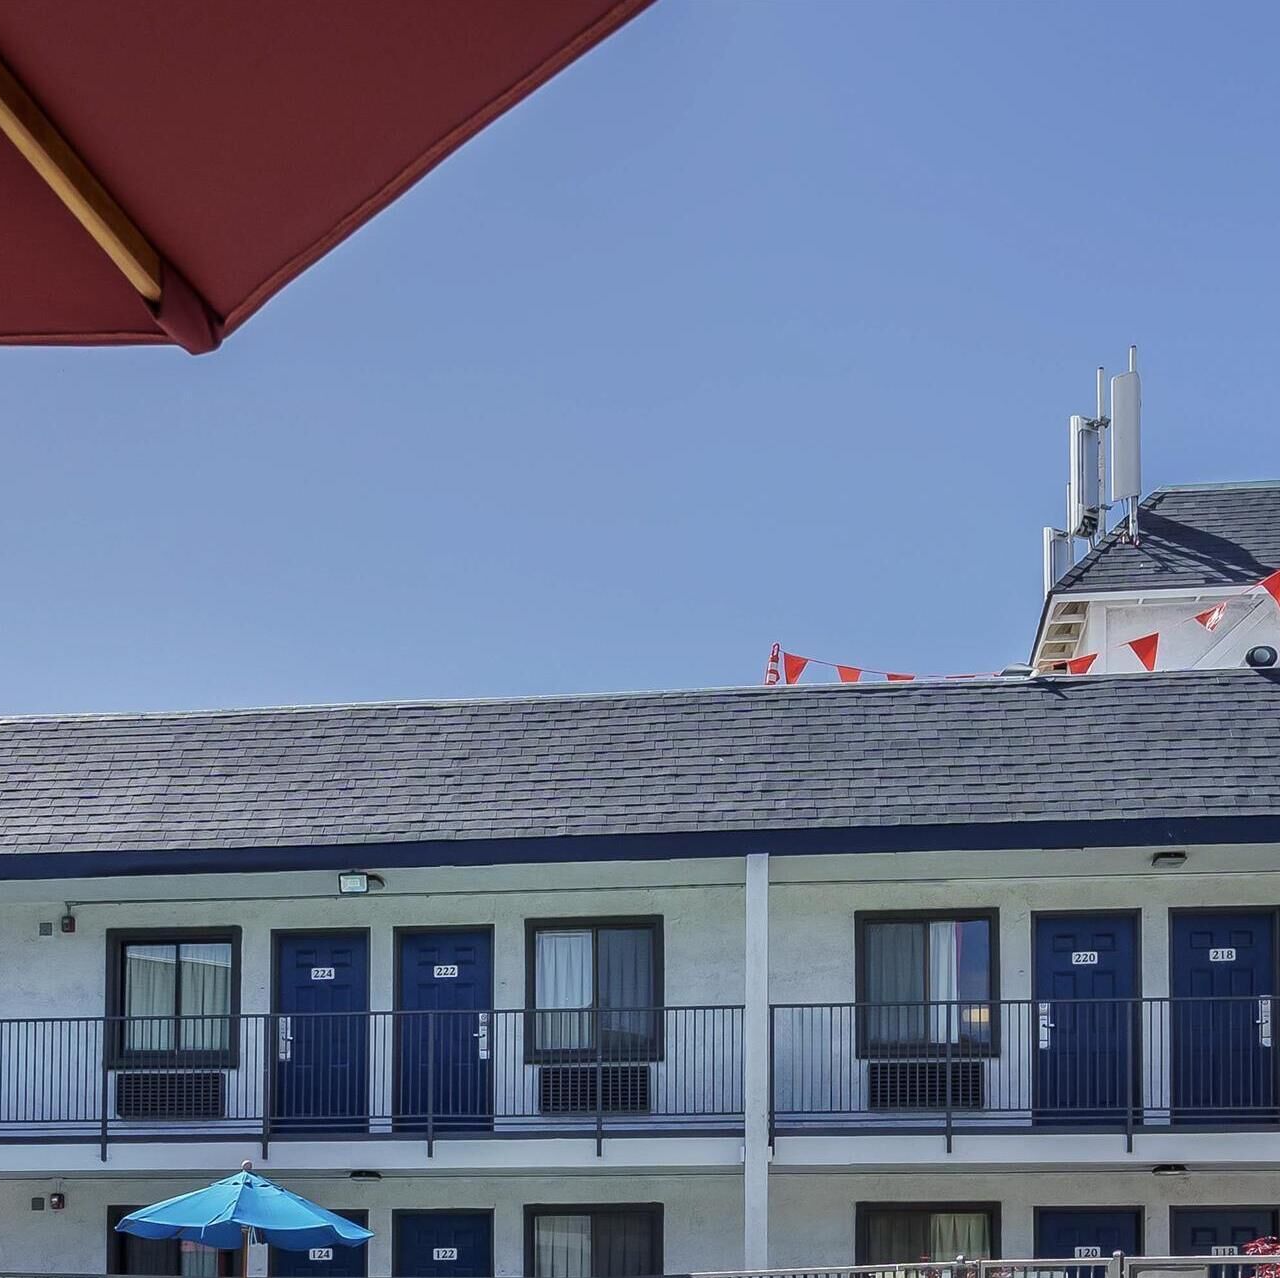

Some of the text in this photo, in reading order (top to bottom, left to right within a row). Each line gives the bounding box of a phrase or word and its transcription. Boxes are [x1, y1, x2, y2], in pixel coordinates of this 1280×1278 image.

[1075, 953, 1095, 962] 220
[1212, 950, 1234, 960] 218
[313, 969, 332, 978] 224
[436, 967, 456, 975] 222
[312, 1250, 330, 1258] 124
[436, 1250, 455, 1258] 122
[1078, 1248, 1098, 1257] 120
[1215, 1248, 1234, 1256] 118
